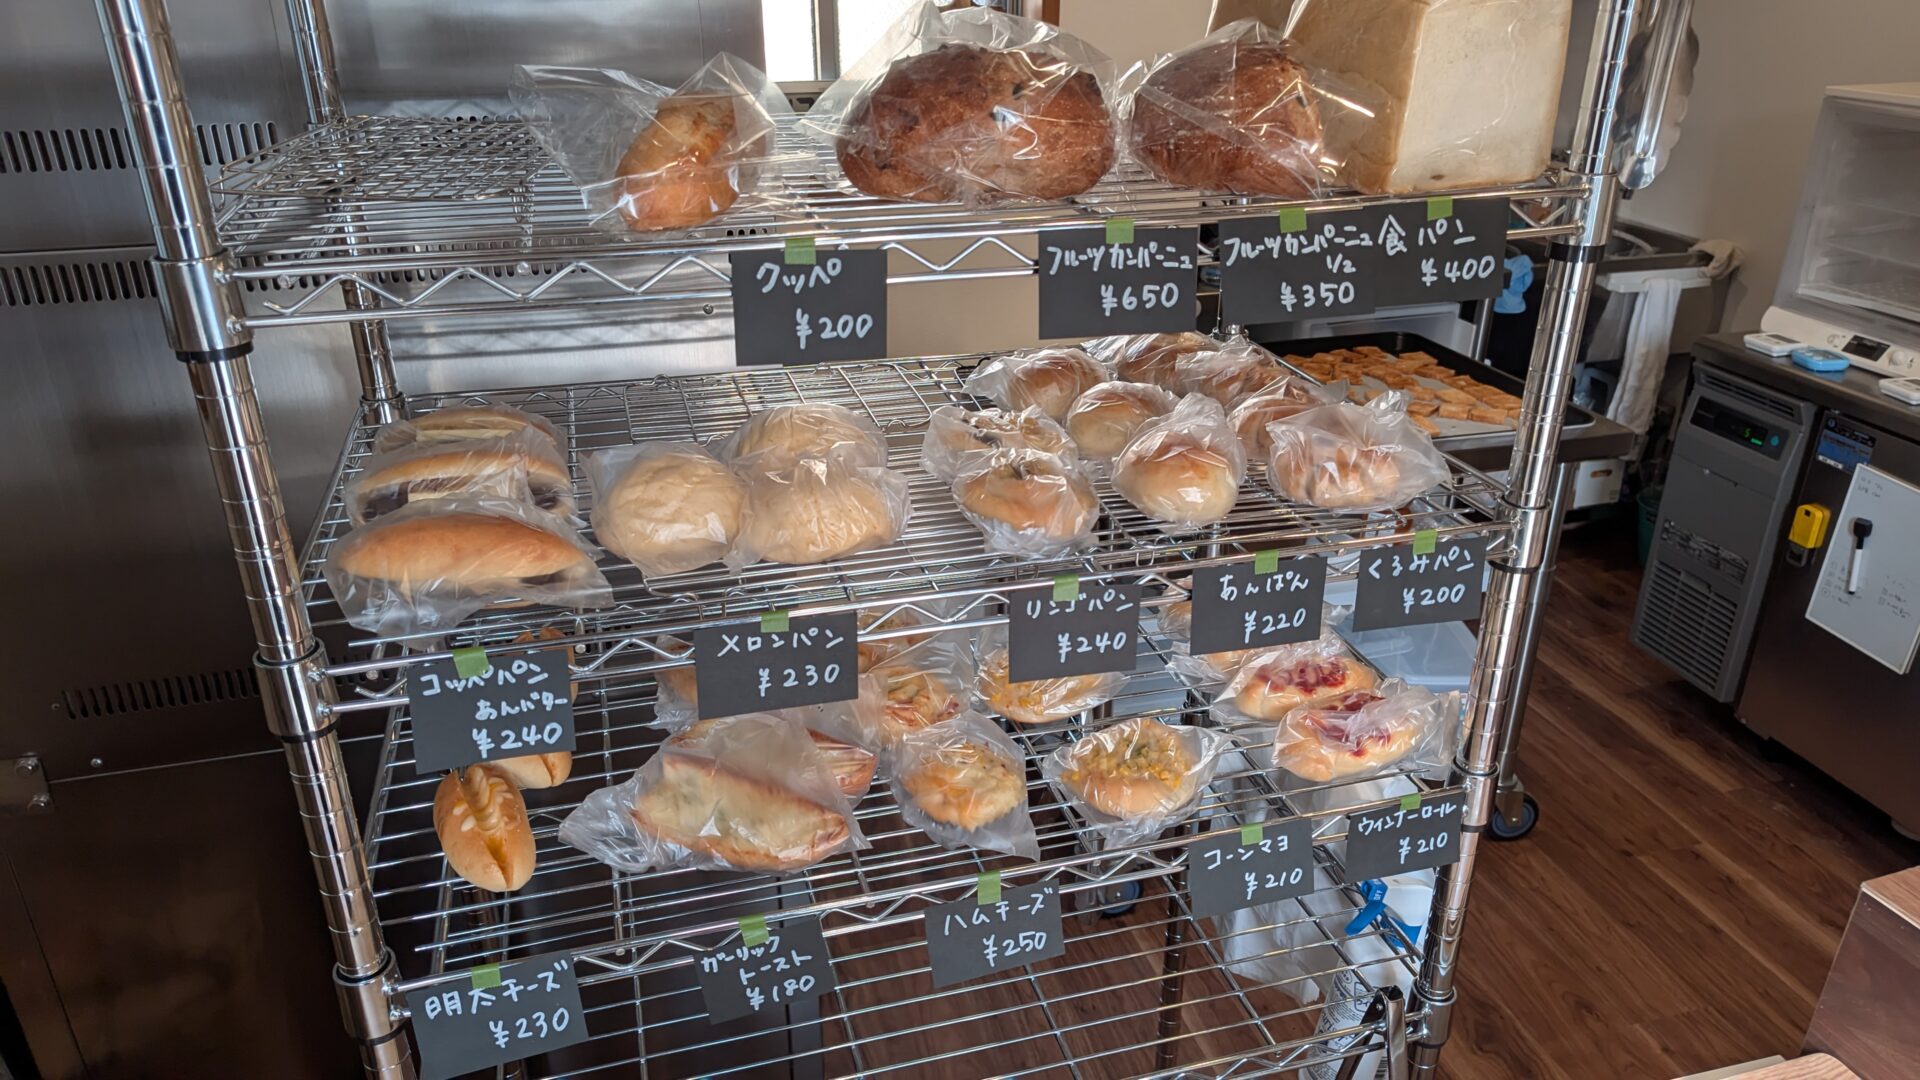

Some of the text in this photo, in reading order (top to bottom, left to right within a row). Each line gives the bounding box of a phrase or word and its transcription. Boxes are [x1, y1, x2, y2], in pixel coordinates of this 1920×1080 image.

[756, 257, 842, 294] クッペ
[1326, 253, 1357, 274] 1/2
[1421, 255, 1496, 287] ¥400
[1100, 282, 1180, 317] ¥650
[1280, 281, 1356, 312] ¥350
[795, 308, 874, 350] ¥200
[1403, 583, 1466, 615] ¥200
[716, 627, 844, 658] メロンパン
[1244, 607, 1306, 644] ¥220
[1058, 631, 1127, 663] ¥240
[758, 663, 840, 698] ¥230
[475, 691, 569, 721] あんバター
[472, 721, 563, 760] ¥240
[1203, 835, 1289, 870] コーンマヨ
[1398, 831, 1449, 865] ¥210
[1244, 867, 1303, 901] ¥210
[944, 887, 1053, 936] ハムチーズ
[982, 931, 1048, 968] ¥250
[739, 949, 813, 986] トースト
[746, 975, 816, 1011] ¥180
[488, 1007, 570, 1049] ¥230
